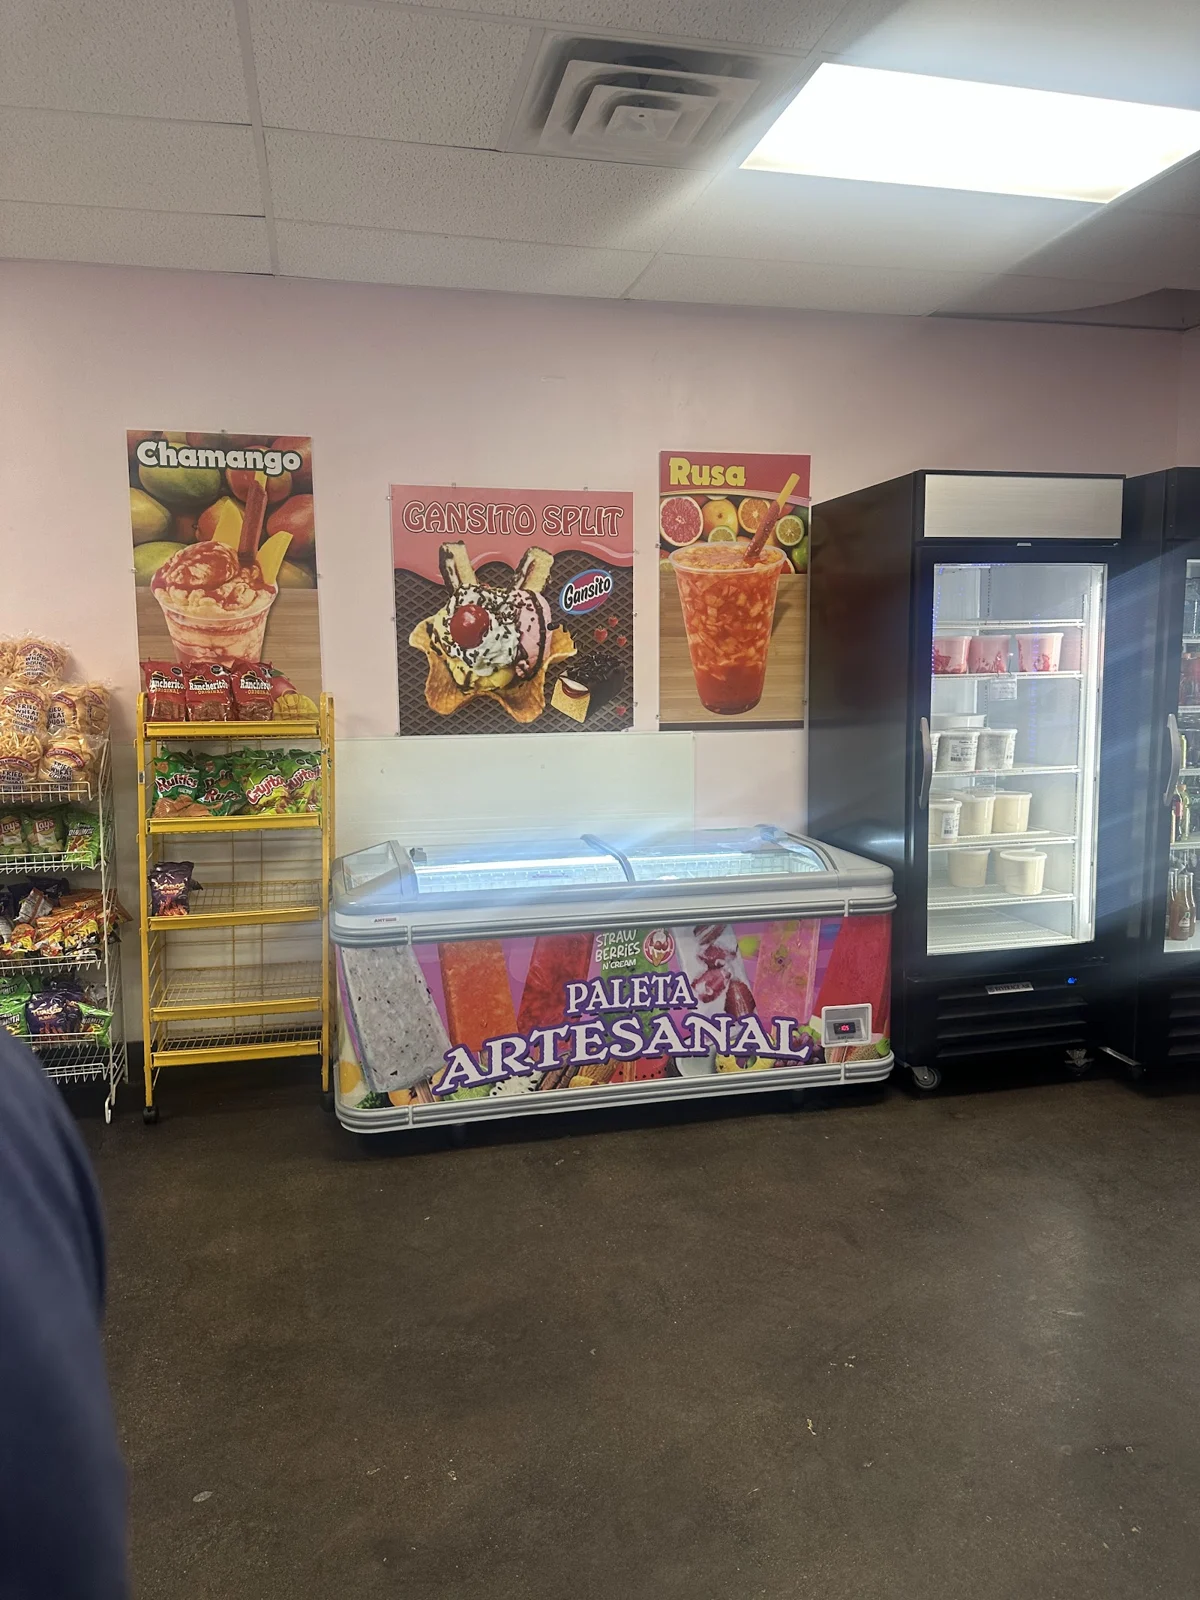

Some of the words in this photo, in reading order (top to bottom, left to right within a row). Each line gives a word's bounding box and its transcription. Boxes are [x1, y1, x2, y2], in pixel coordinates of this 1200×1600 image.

[137, 441, 302, 475] Chamango
[669, 456, 747, 487] Rusa
[402, 501, 537, 536] GANSITO
[542, 505, 624, 537] SPLIT
[562, 575, 612, 612] Gansito
[595, 929, 637, 947] STRAW
[565, 974, 695, 1014] PALETA
[434, 1015, 810, 1094] ARTESANAL
